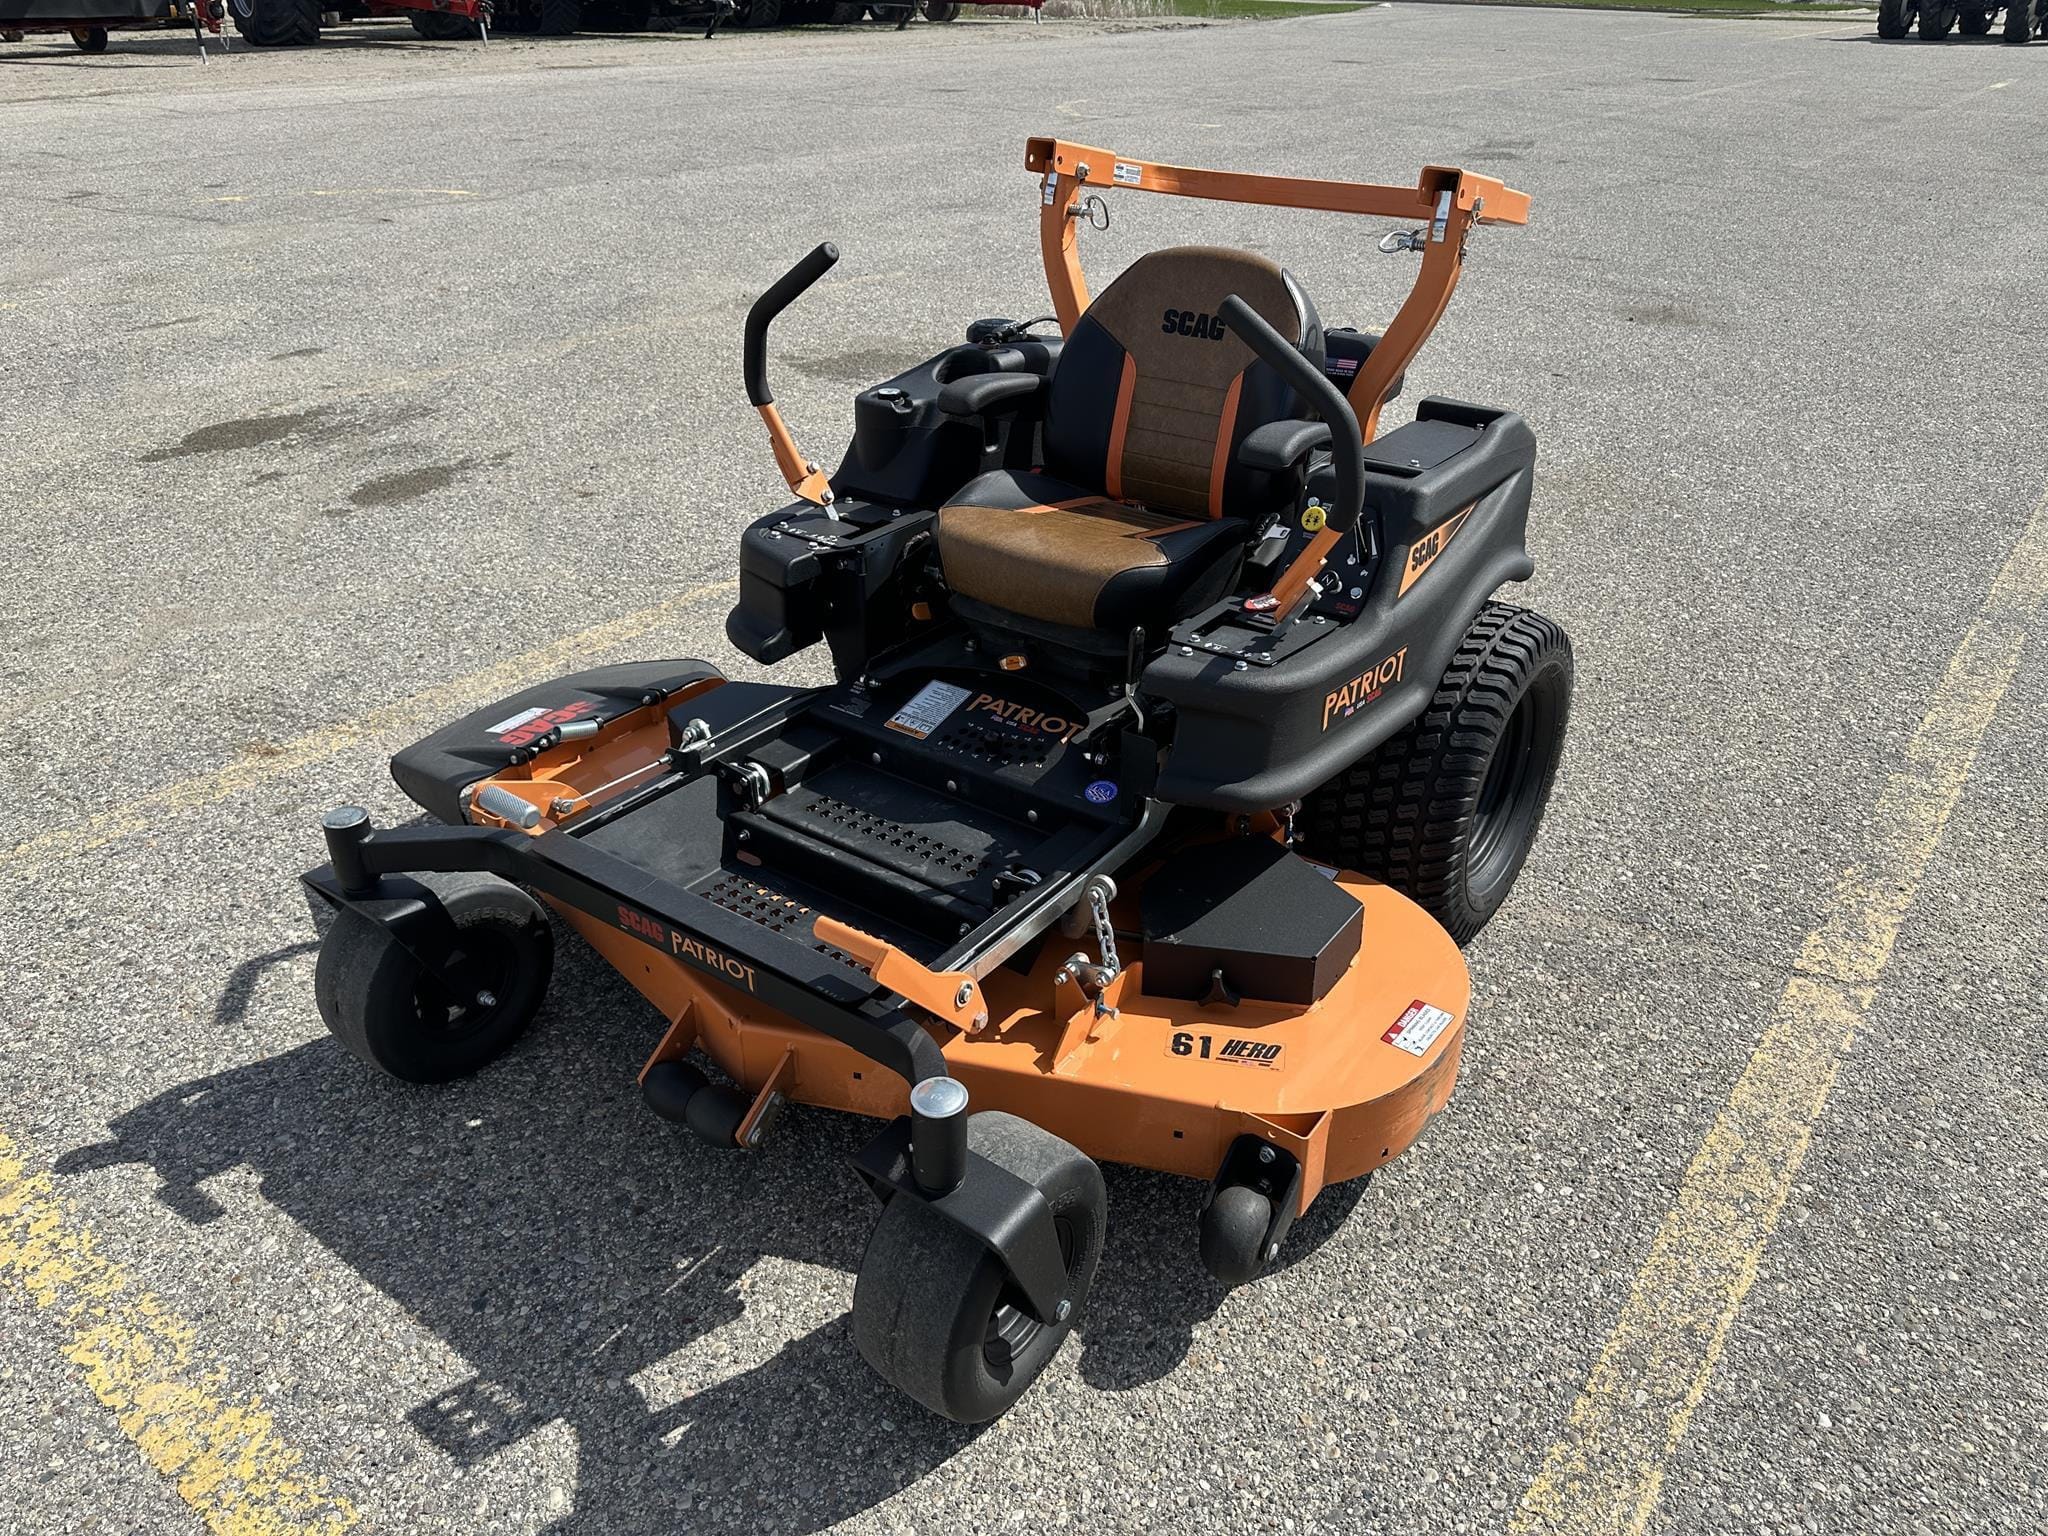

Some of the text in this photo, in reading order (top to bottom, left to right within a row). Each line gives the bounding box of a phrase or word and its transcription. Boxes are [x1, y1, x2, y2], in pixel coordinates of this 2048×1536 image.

[1161, 308, 1227, 341] SCAG
[1411, 532, 1440, 572] SCAG
[1322, 646, 1408, 732] PATRIOT
[499, 700, 598, 745] SCAG
[966, 693, 1084, 744] PATRIOT
[617, 904, 755, 992] SCAG PATRIOT
[1396, 1007, 1420, 1028] DANGER
[1171, 1032, 1282, 1060] 61 HERO
